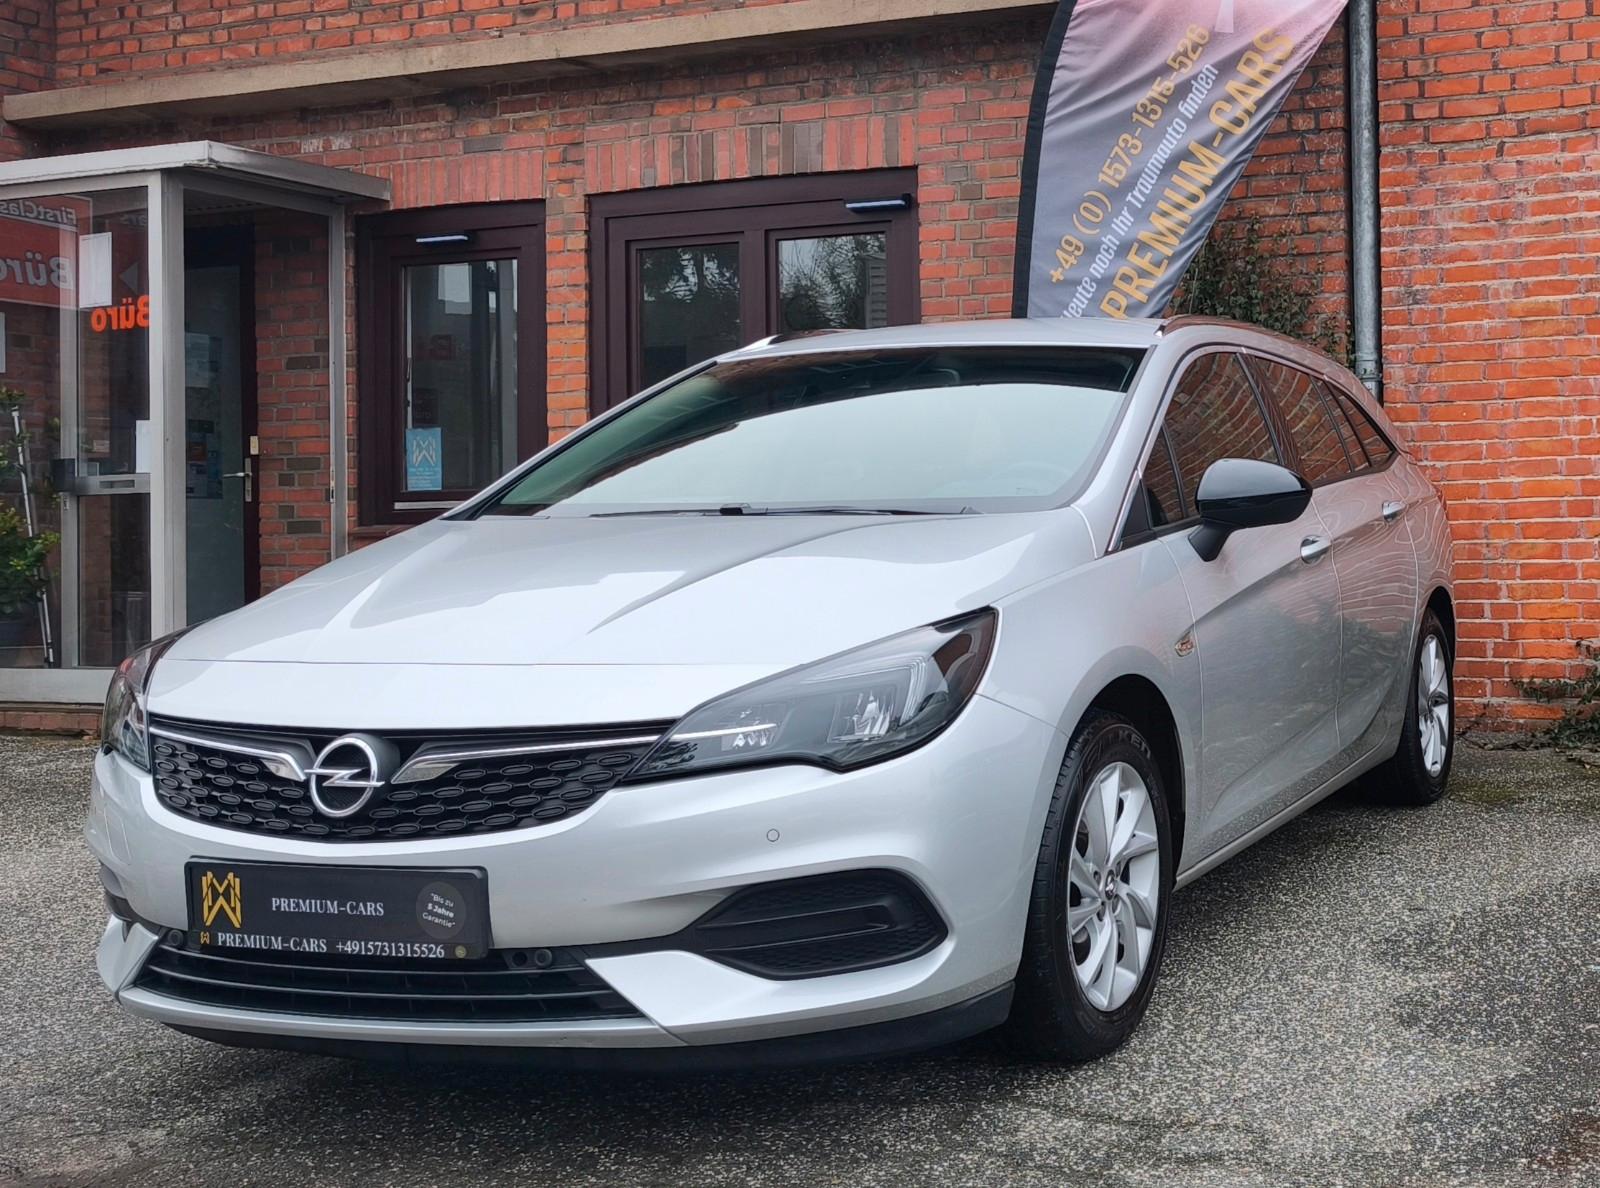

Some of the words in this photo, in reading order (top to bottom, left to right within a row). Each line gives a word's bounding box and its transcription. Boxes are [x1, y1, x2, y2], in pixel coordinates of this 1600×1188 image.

[1049, 234, 1085, 283] +49
[1073, 190, 1112, 235] (0)
[1098, 24, 1210, 188] 1573-1315-526
[1089, 234, 1120, 279] noch
[1111, 206, 1135, 236] Ihr
[1125, 117, 1187, 209] Traumauto
[1178, 63, 1219, 120] finden
[1100, 27, 1295, 320] PREMIUM-CARS
[217, 931, 328, 953] PREMIUM-CARS
[335, 940, 446, 959] +4915731315526
[271, 897, 385, 917] PREMIUM-CARS
[433, 905, 455, 918] Jahre
